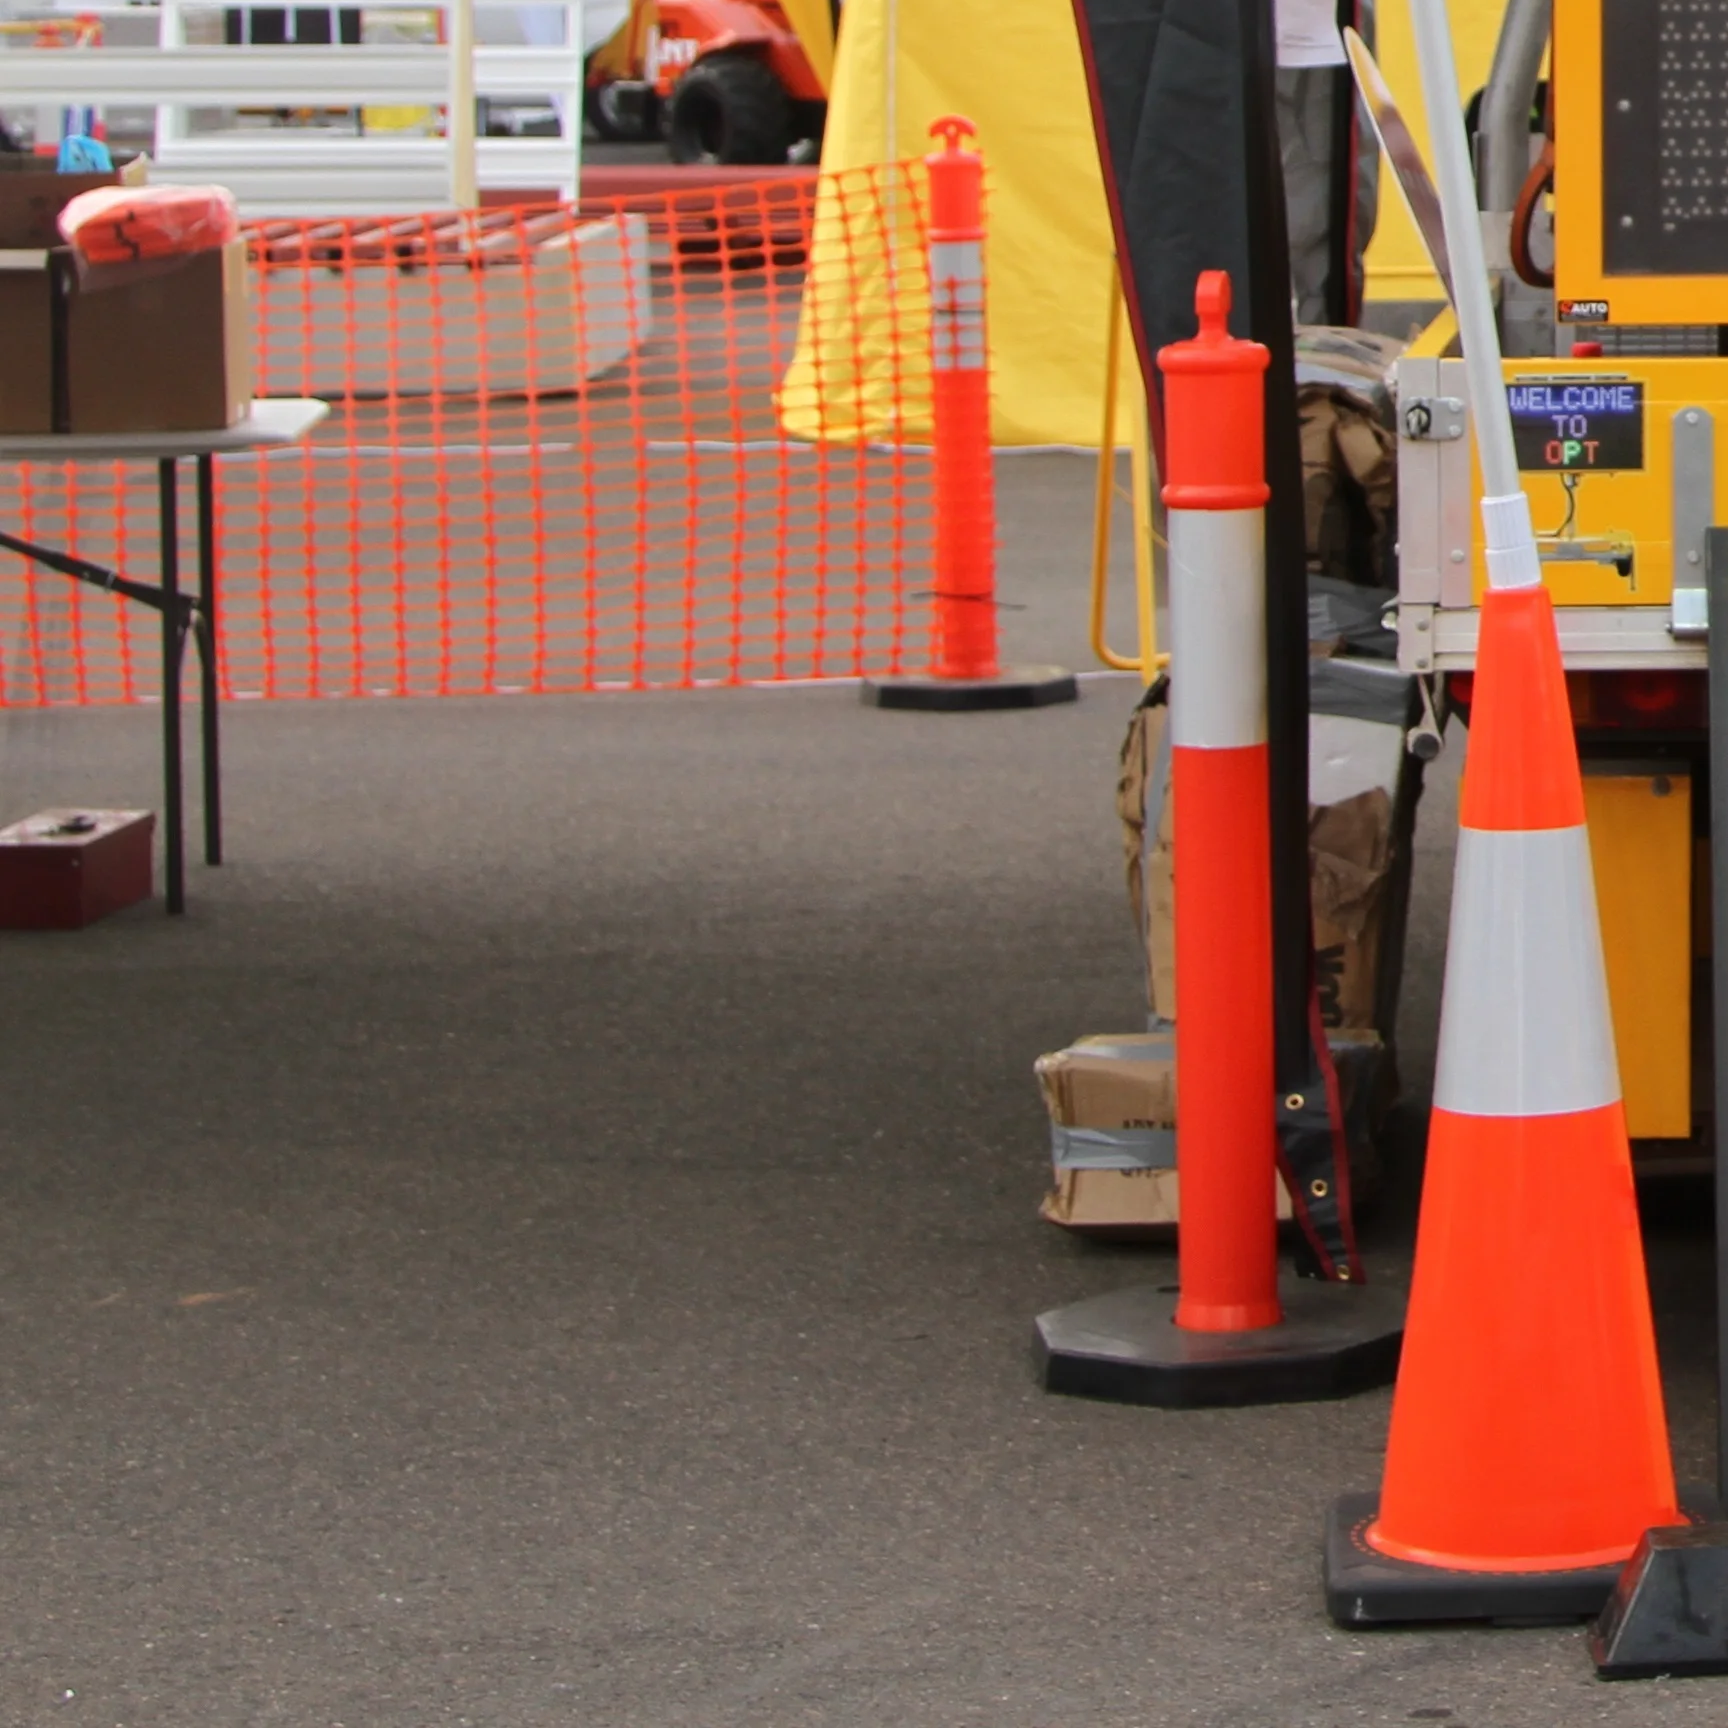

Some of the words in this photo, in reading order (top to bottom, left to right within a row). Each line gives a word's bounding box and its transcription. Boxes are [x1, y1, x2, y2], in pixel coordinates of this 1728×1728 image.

[1509, 386, 1635, 411] WELCOME
[1551, 414, 1588, 439] TO
[1544, 440, 1600, 465] OPT
